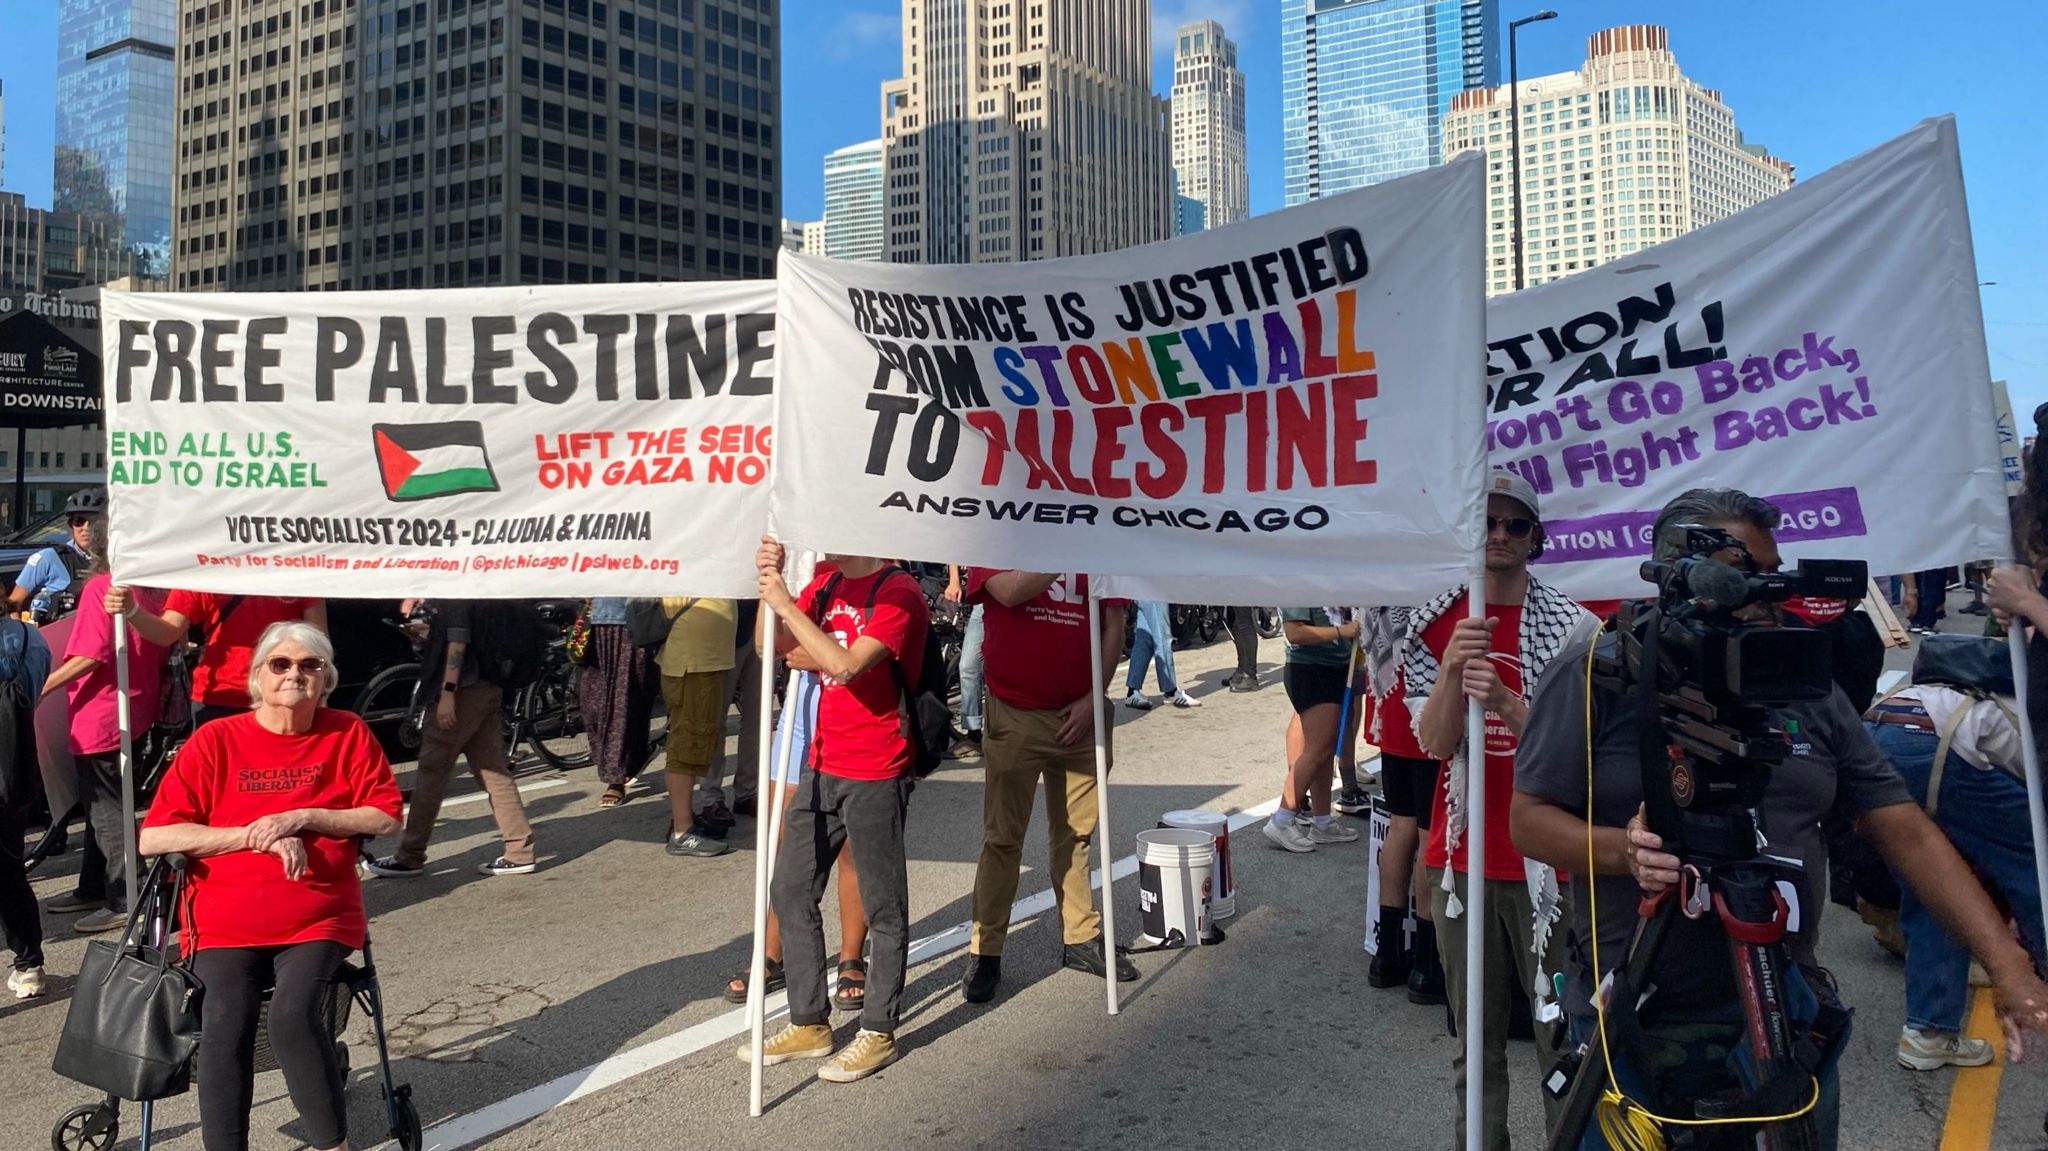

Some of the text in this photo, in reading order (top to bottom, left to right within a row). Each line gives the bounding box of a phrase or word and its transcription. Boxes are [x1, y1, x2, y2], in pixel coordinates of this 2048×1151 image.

[848, 226, 1369, 343] RESISTANCE IS JUSTIFIED
[115, 312, 776, 404] FREE PALESTINE
[866, 289, 1377, 409] FROM STONEWALL
[1554, 301, 1728, 397] ALL!
[1607, 380, 1684, 424] Go
[1694, 331, 1862, 404] Back,
[111, 431, 301, 458] END ALL U.S.
[535, 431, 615, 461] LIFT
[627, 427, 688, 457] THE
[864, 374, 1379, 500] TO PALESTINE
[1562, 426, 1702, 489] Fight
[1713, 376, 1879, 451] Back!
[110, 461, 329, 489] AID TO ISRAEL
[537, 455, 773, 490] ON GAZA NO
[225, 515, 281, 544] VOTE
[282, 516, 394, 545] SOCIALIST
[556, 513, 576, 542] &
[576, 511, 652, 542] KARINA
[879, 490, 1330, 533] ANSWER CHICAGO
[196, 554, 242, 568] Party
[247, 553, 268, 567] for
[273, 554, 349, 570] Socialism
[352, 557, 381, 570] and
[384, 556, 460, 572] Liberation
[239, 763, 324, 781] SOCIALISM
